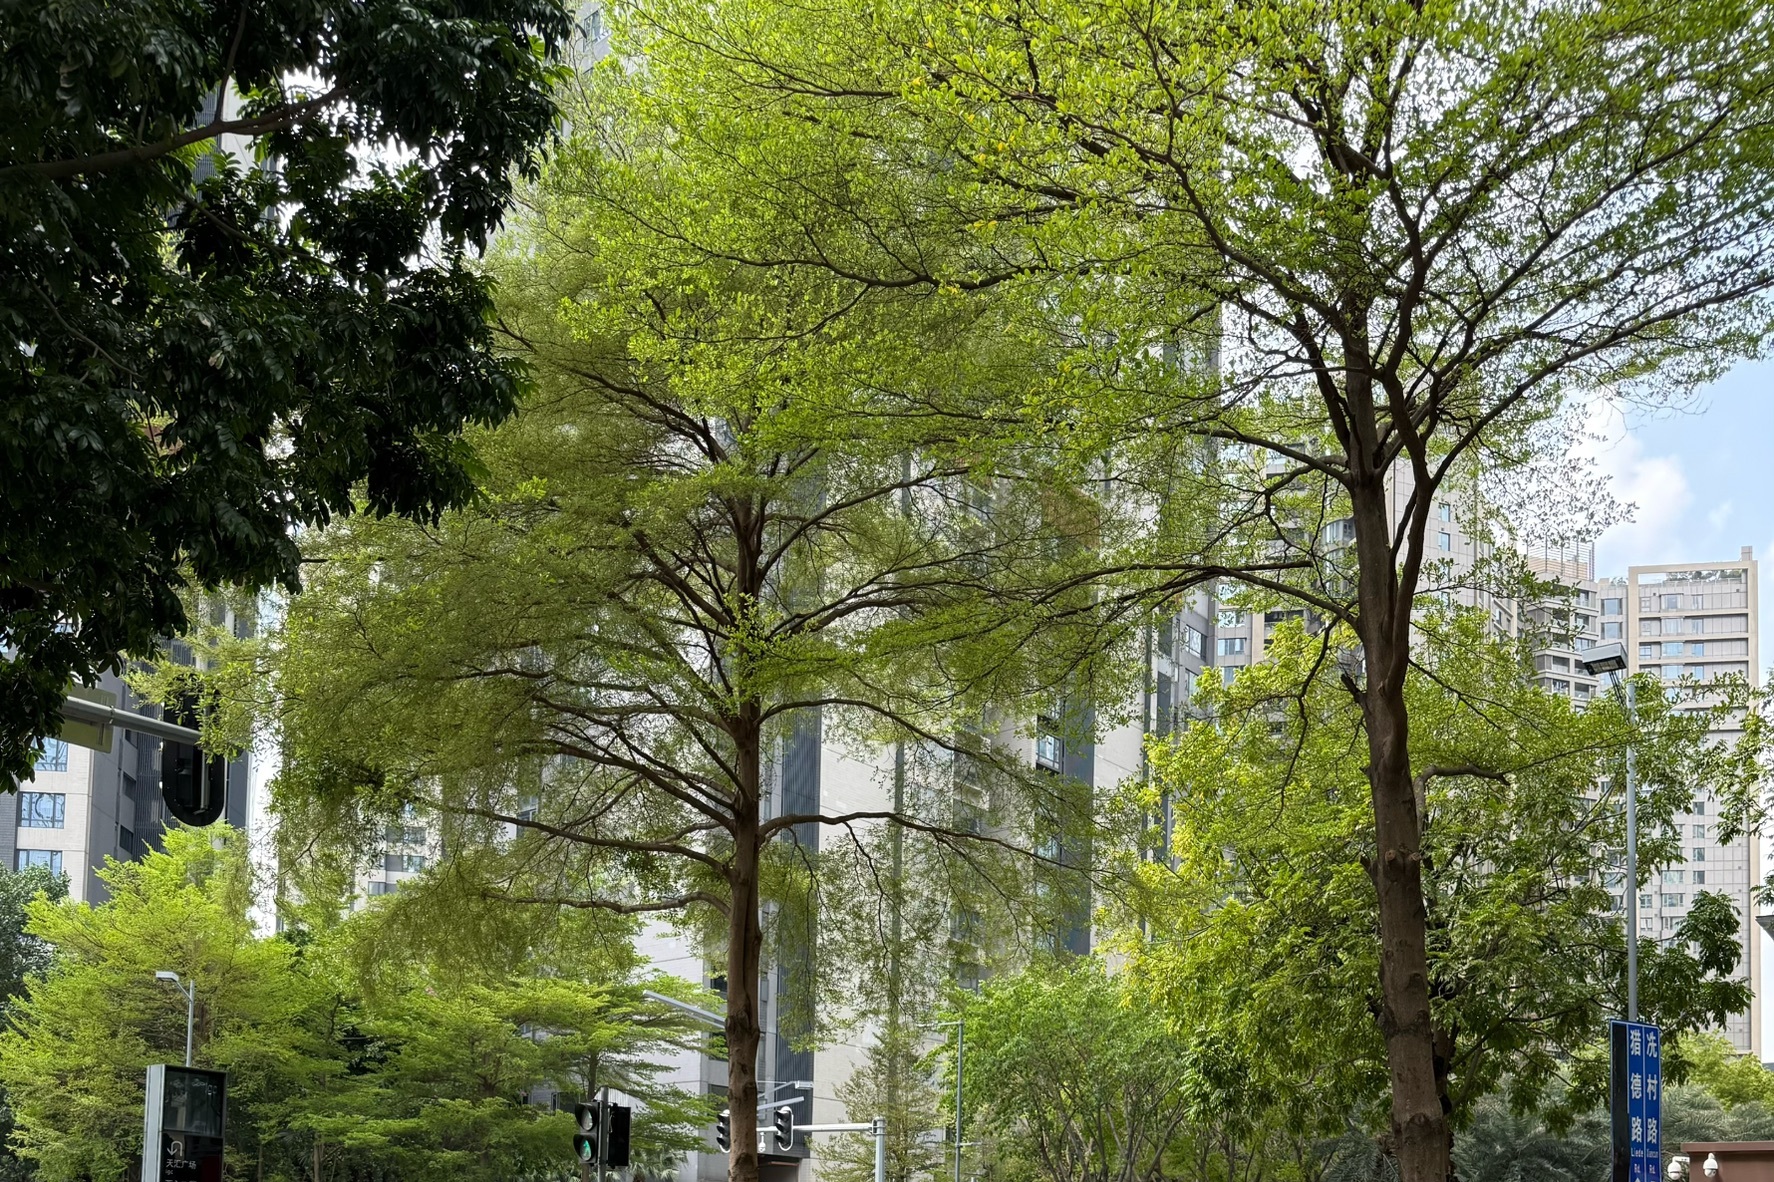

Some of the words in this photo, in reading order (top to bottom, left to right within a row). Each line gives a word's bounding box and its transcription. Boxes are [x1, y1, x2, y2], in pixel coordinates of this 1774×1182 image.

[1630, 1028, 1643, 1144] 猎德路
[1646, 1031, 1659, 1145] 冼村路
[165, 1158, 197, 1170] 天汇广场
[1630, 1147, 1644, 1158] Liede
